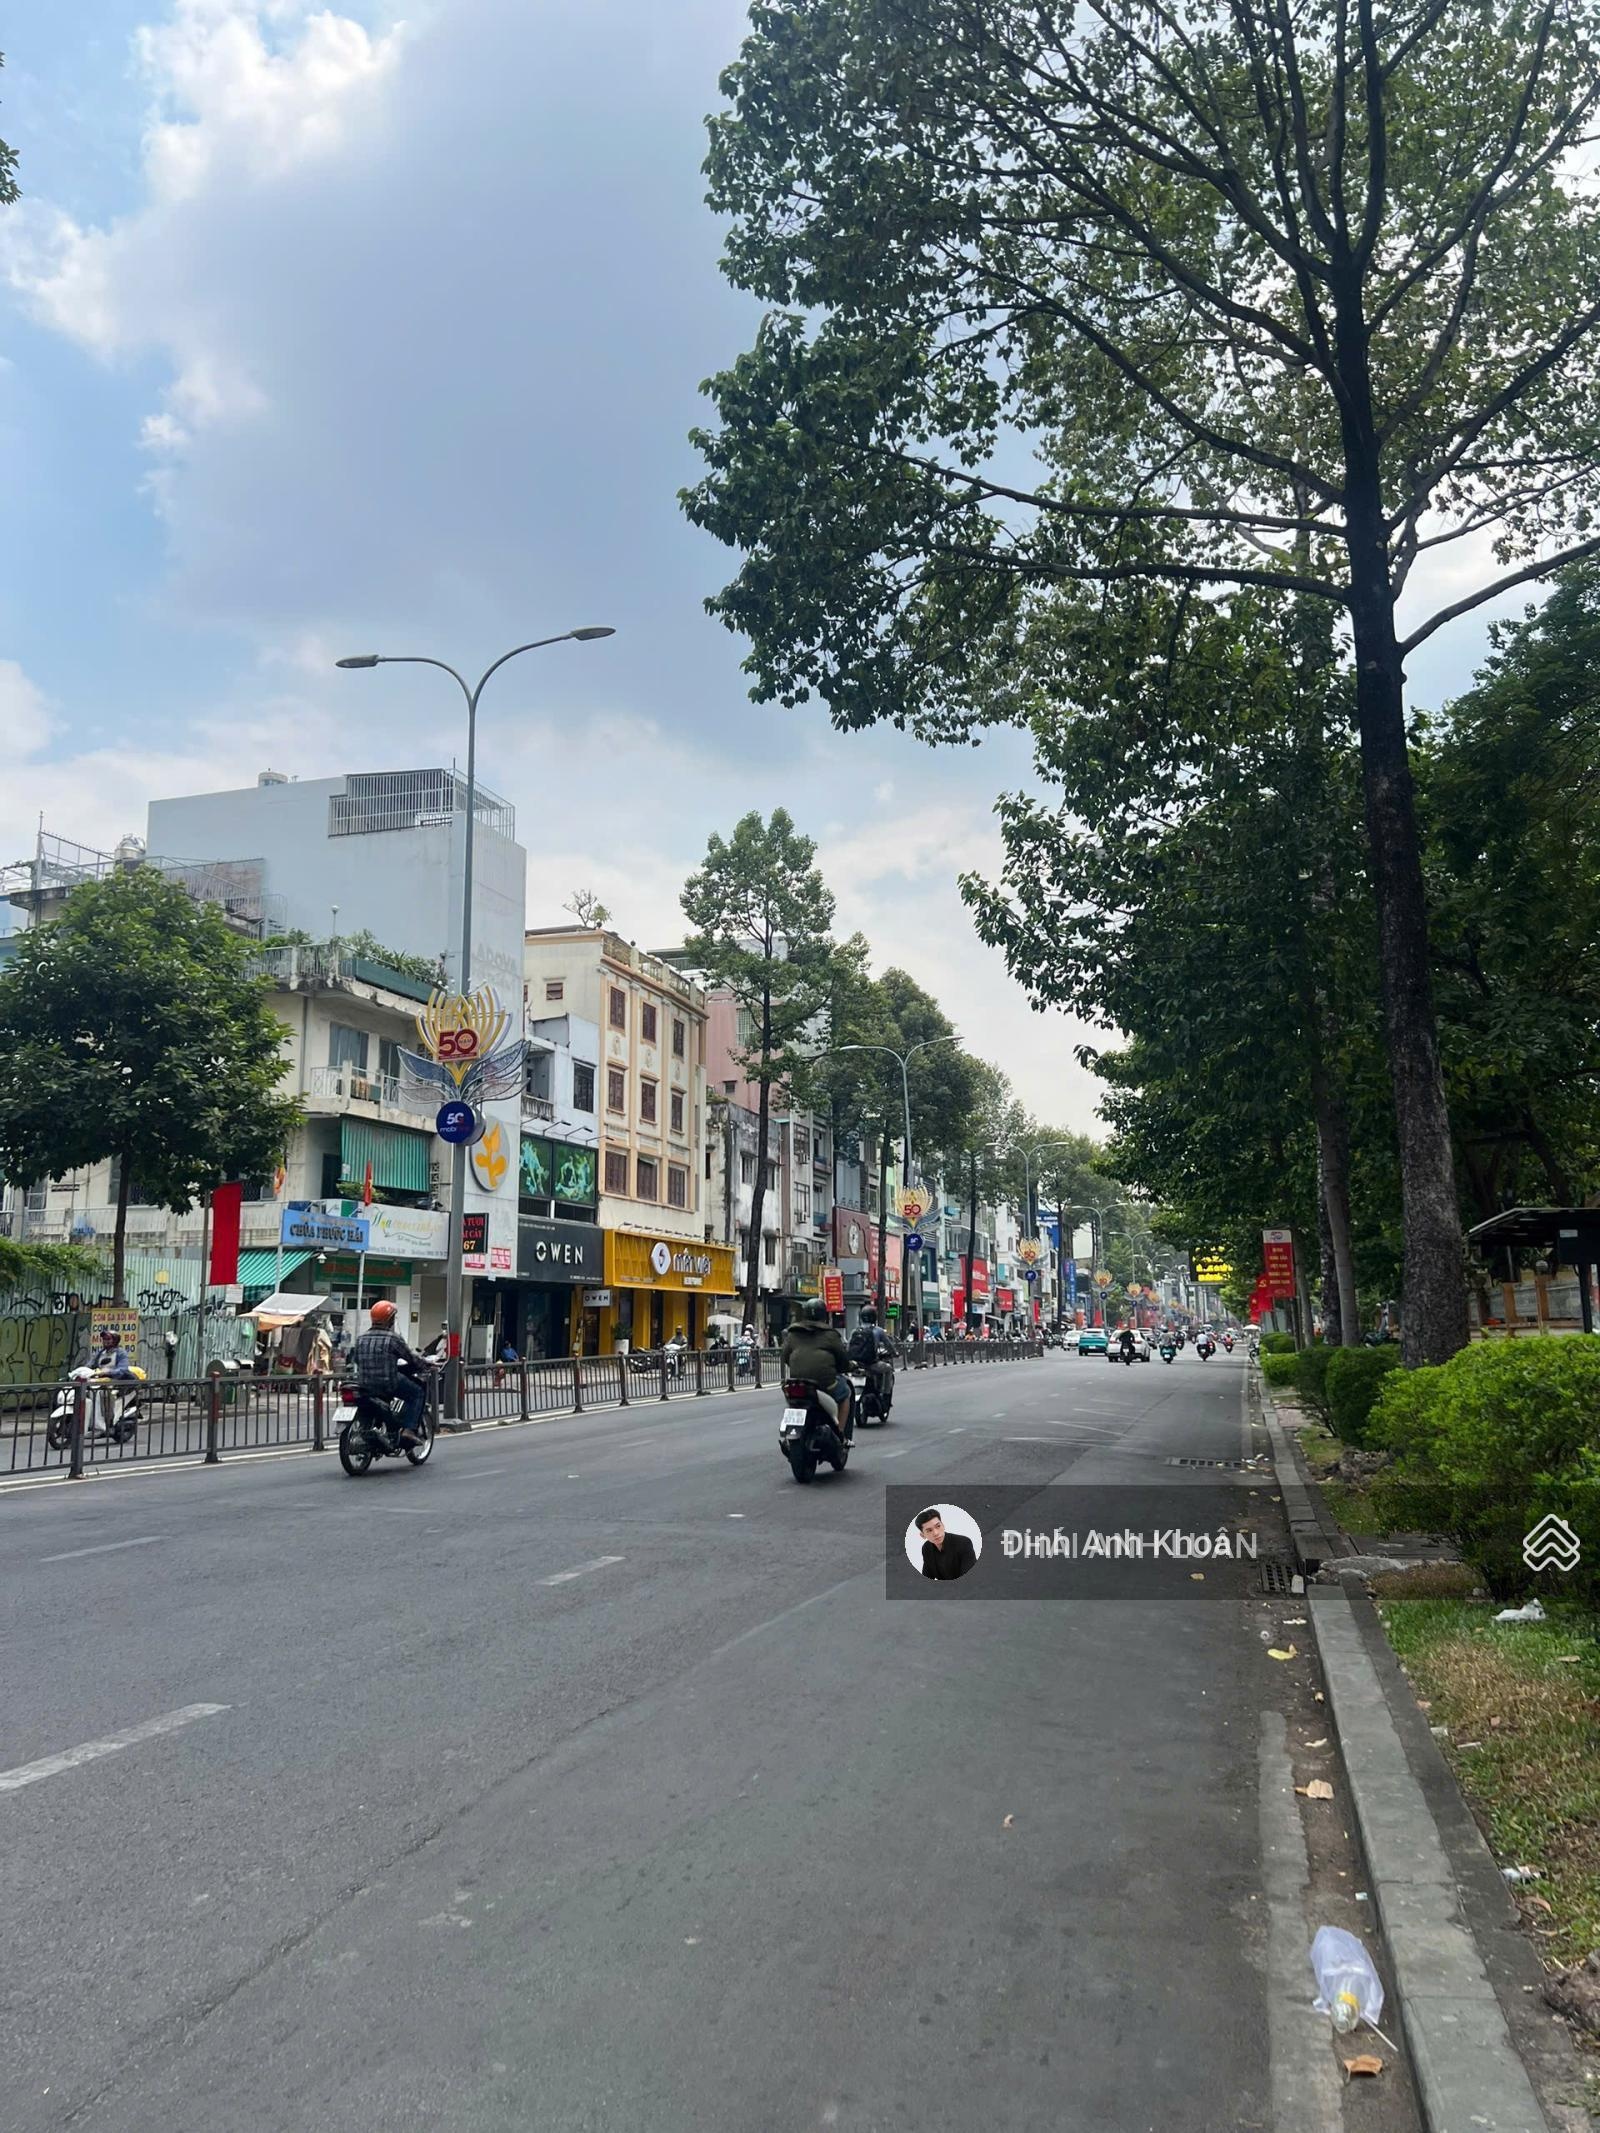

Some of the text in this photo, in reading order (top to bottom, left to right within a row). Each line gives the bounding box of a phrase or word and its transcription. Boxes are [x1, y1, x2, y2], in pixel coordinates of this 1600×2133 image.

[438, 1028, 478, 1056] 50
[446, 1112, 465, 1125] 5G
[904, 1204, 921, 1215] 50
[463, 1240, 476, 1250] 67
[536, 1241, 583, 1265] OWEN
